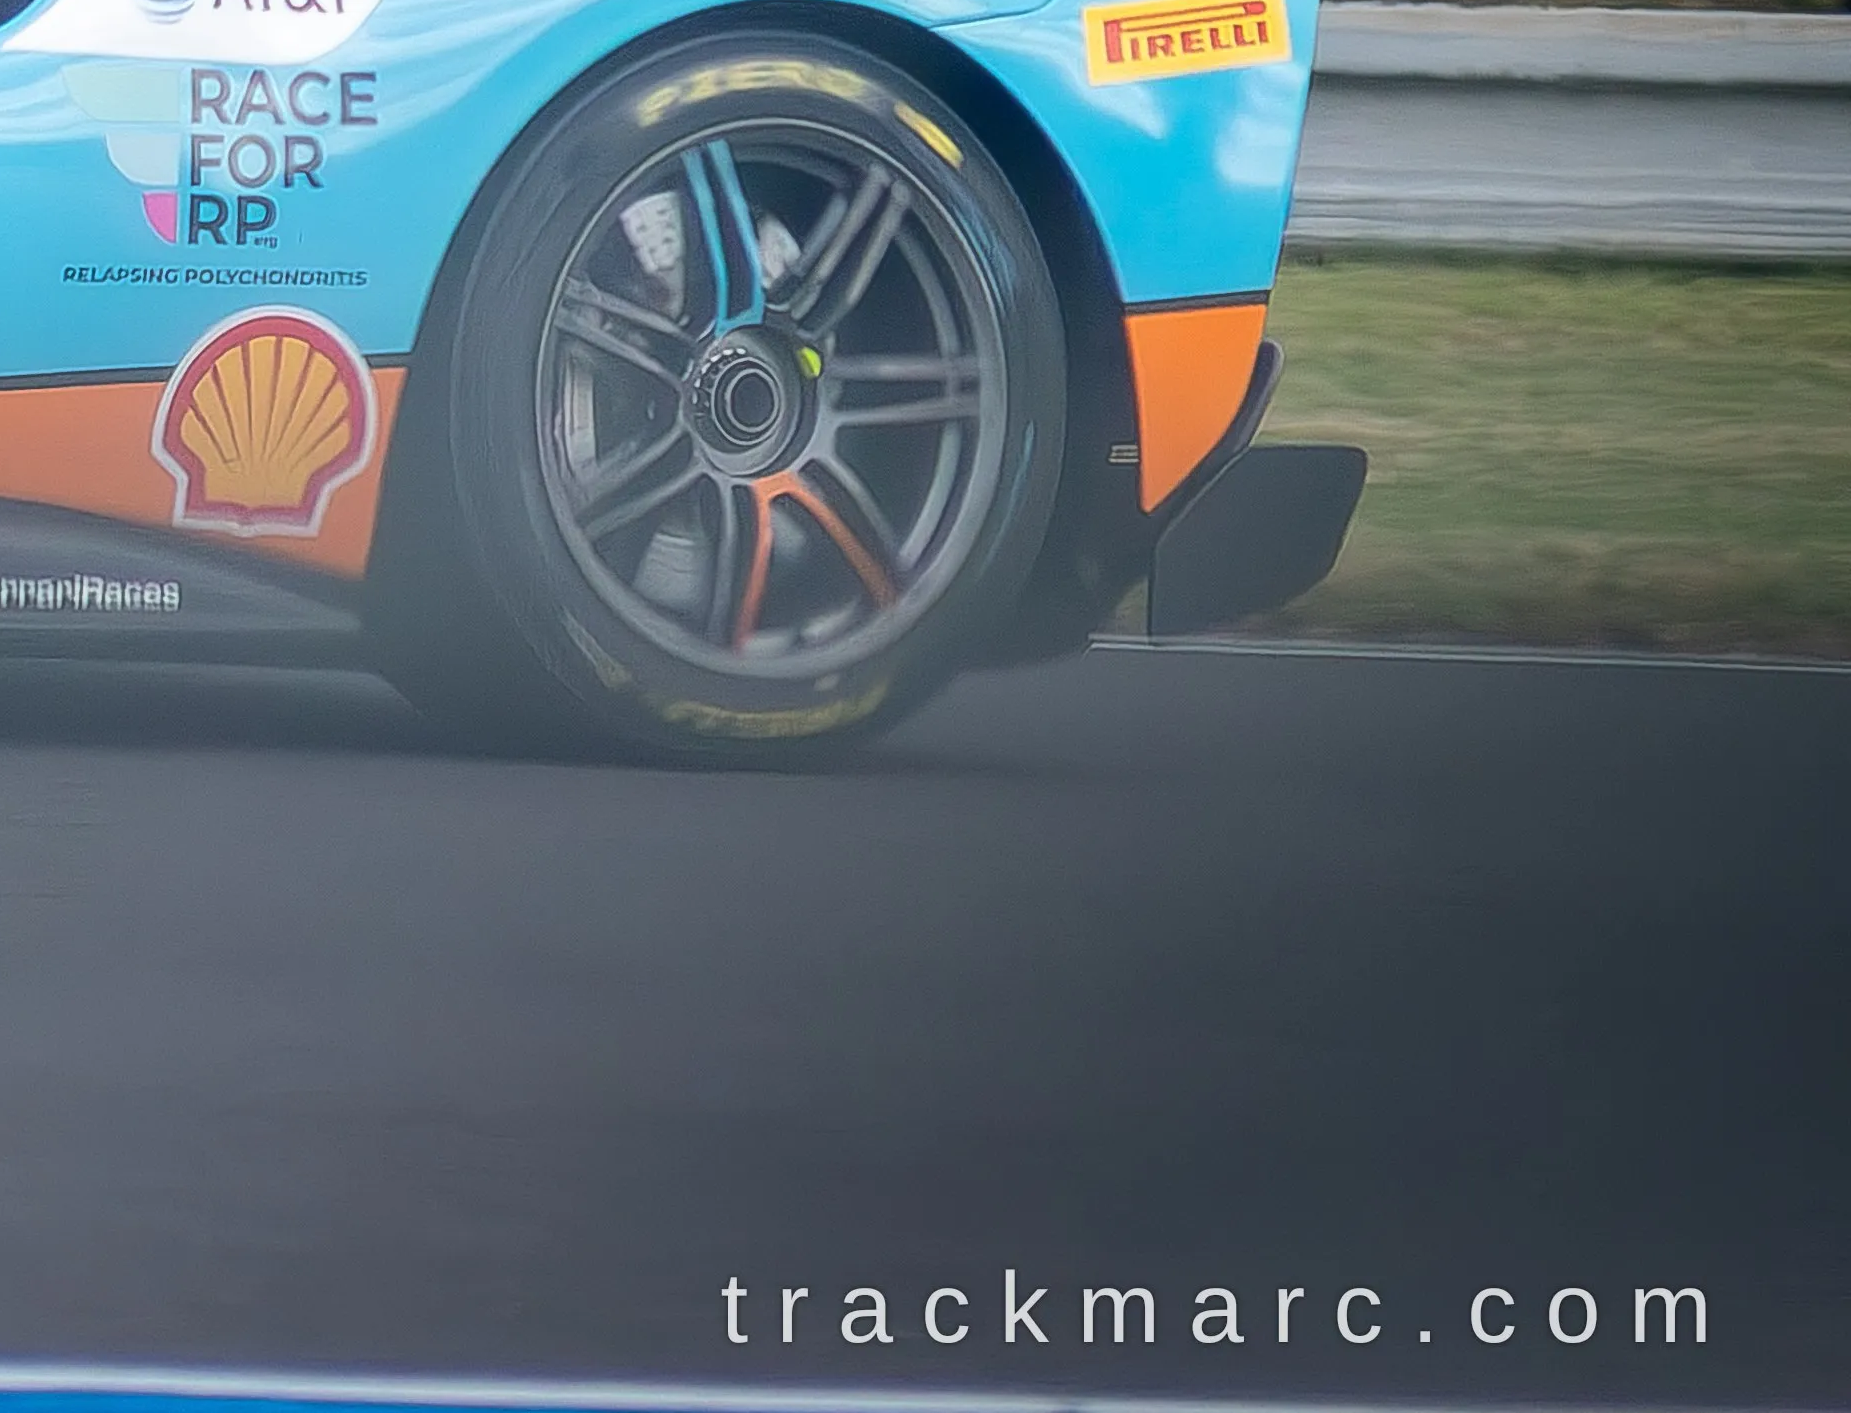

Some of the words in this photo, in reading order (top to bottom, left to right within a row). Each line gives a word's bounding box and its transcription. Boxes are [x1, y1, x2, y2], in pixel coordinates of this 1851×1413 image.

[1103, 0, 1270, 63] PIRELLI
[190, 67, 378, 126] RACE
[190, 133, 325, 188] FOR
[62, 266, 180, 285] RELAPSING
[184, 267, 369, 287] POLYCHONDRITIS
